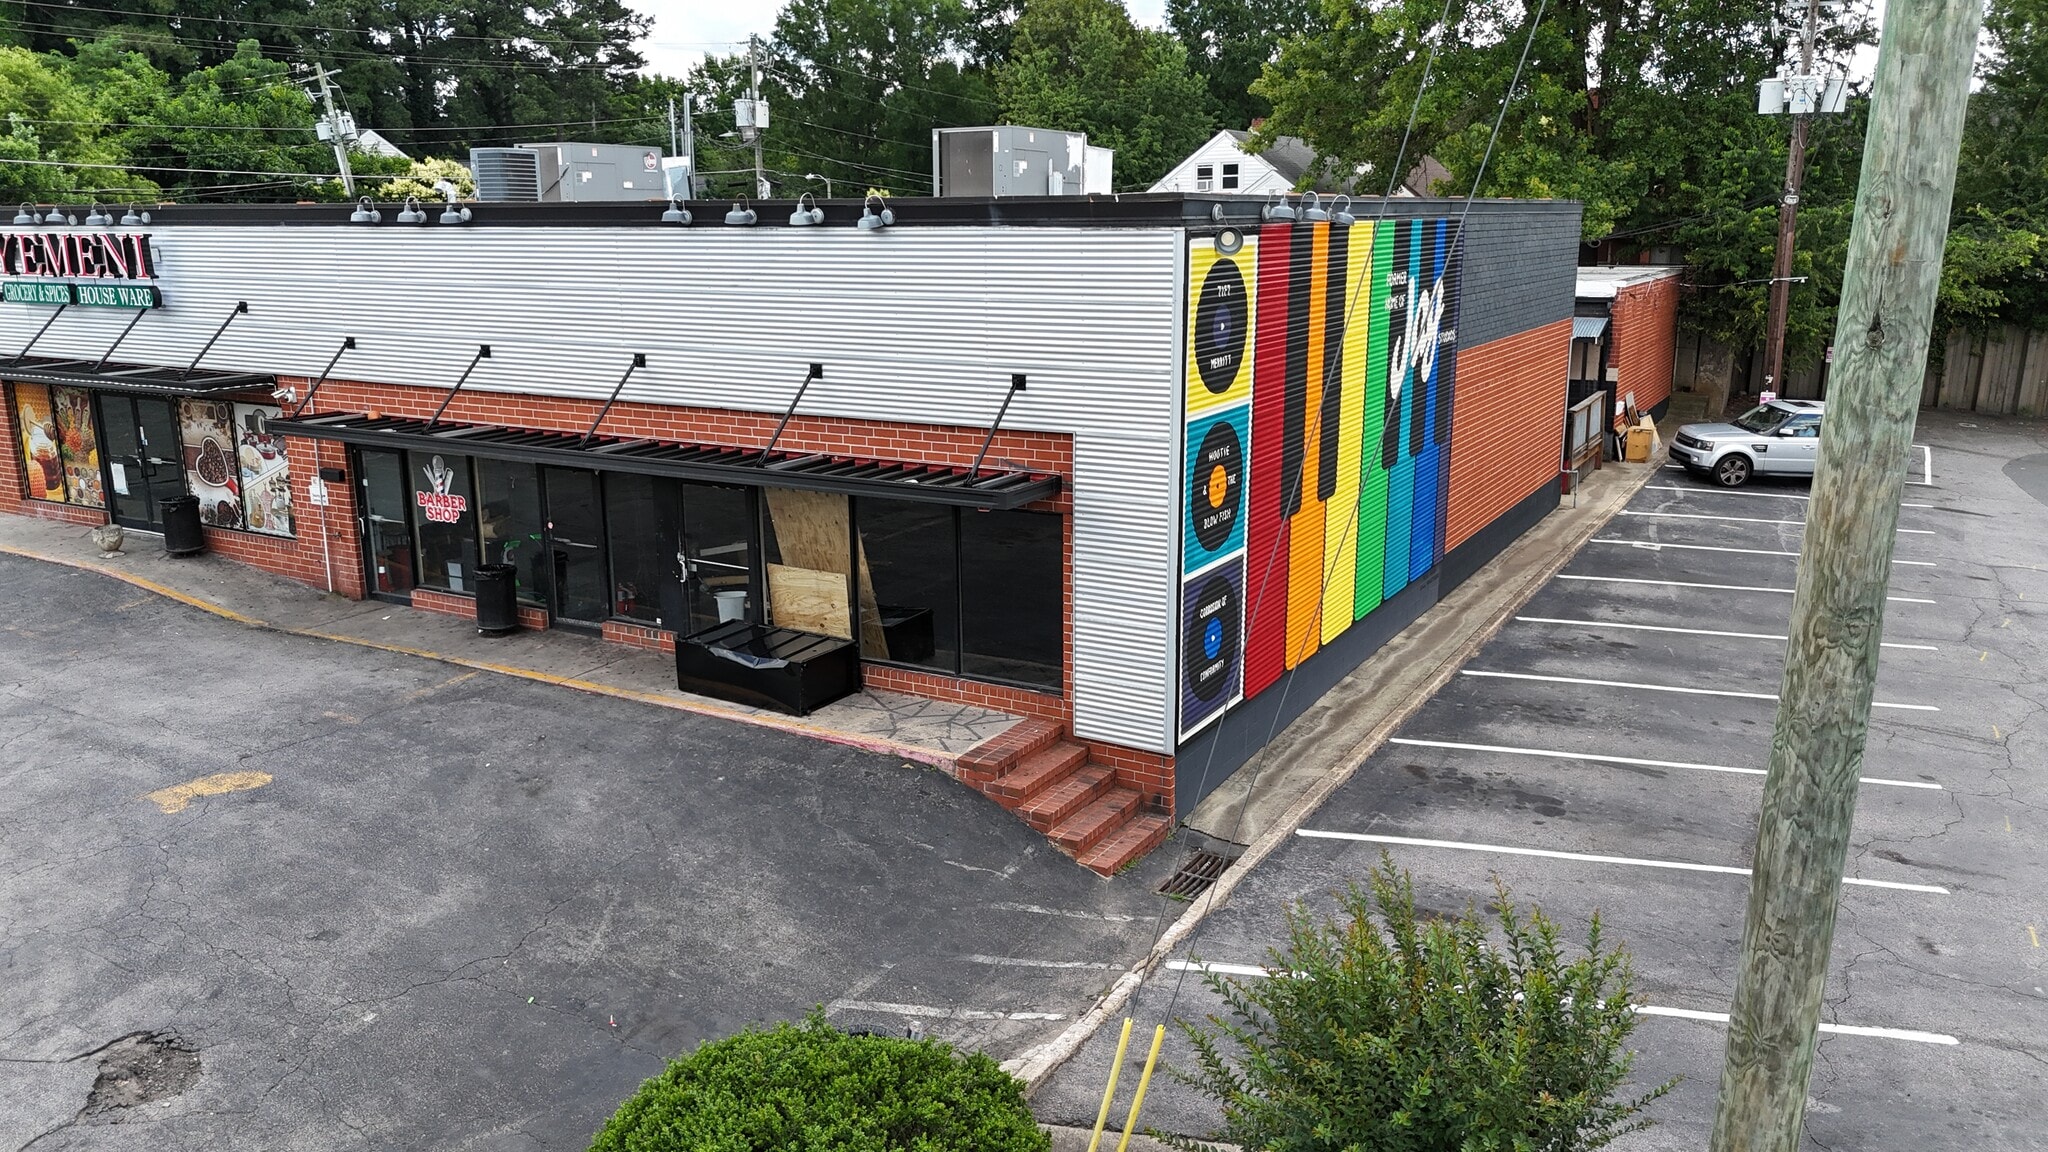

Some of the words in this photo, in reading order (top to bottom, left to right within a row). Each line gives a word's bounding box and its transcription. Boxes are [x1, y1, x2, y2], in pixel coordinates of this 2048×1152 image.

[1387, 271, 1407, 286] FORMER
[4, 283, 37, 302] GROCERY
[38, 284, 45, 302] &
[45, 283, 71, 303] SPICES
[77, 286, 117, 305] HOUSE
[117, 288, 153, 306] WARE
[1398, 294, 1407, 308] OF
[1211, 354, 1231, 369] MERRITT
[1208, 445, 1229, 462] HOOTIE
[1227, 474, 1236, 485] THE
[1203, 485, 1207, 495] &
[417, 491, 467, 511] BARBER
[426, 506, 460, 523] SHOP
[1204, 514, 1219, 529] BLOW
[1219, 508, 1231, 522] FISH
[1221, 595, 1227, 606] OF
